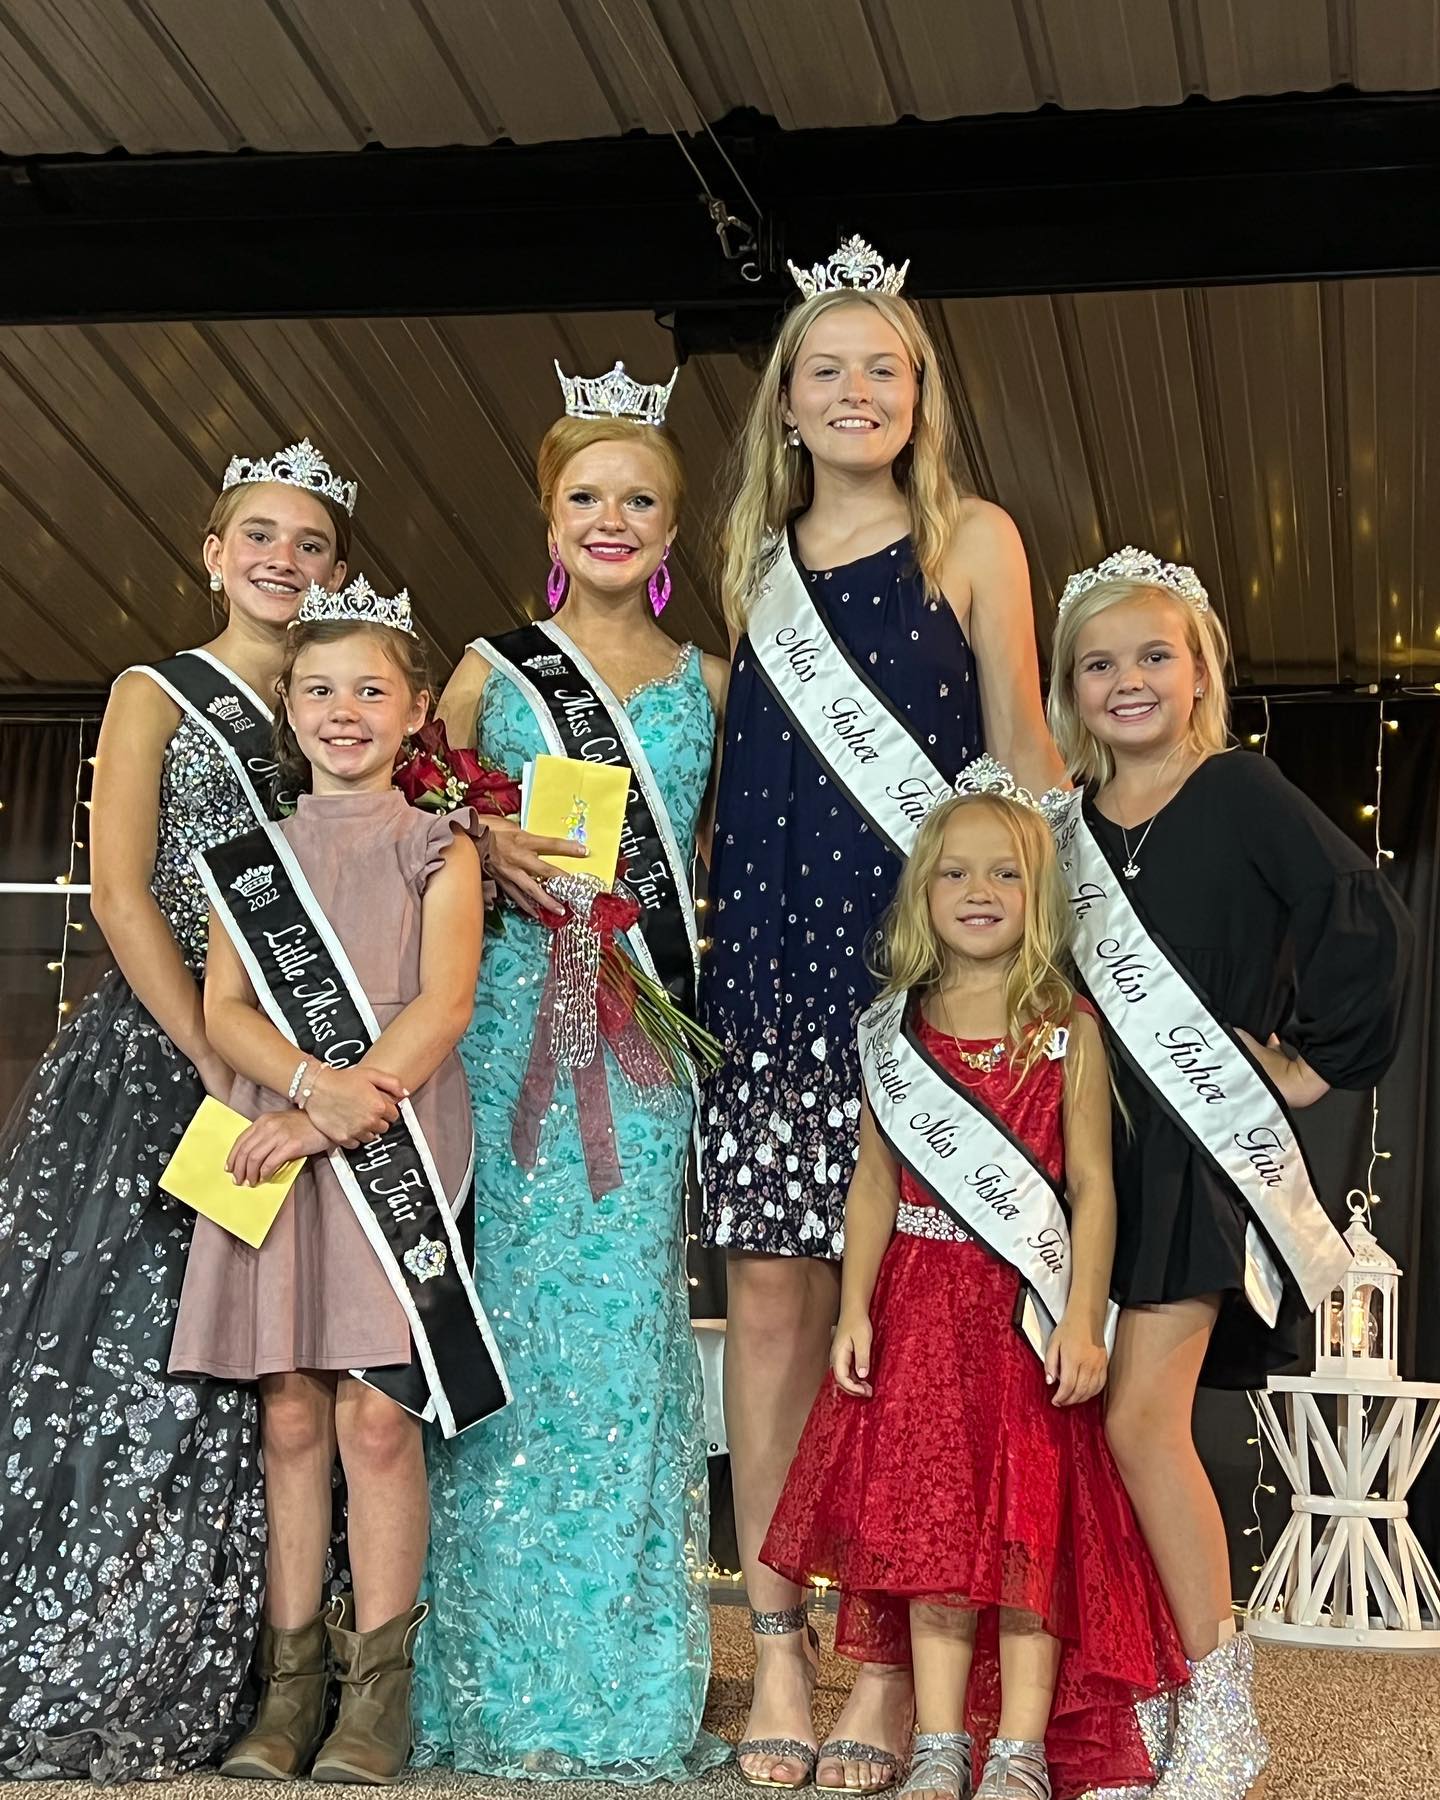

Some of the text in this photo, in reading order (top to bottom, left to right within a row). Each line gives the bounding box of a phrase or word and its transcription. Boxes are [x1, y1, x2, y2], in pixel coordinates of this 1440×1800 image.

[229, 717, 256, 734] 2022
[540, 666, 569, 678] 2022
[775, 627, 821, 683] Miss
[822, 697, 880, 764] Fisher
[554, 688, 602, 737] Miss
[624, 860, 670, 910] Fair
[247, 887, 281, 912] 2022
[262, 924, 306, 982] Little
[292, 978, 342, 1042] Miss
[369, 1168, 425, 1223] Fair
[1096, 938, 1148, 1004] Miss
[1155, 1025, 1226, 1105] Fisher
[1234, 1127, 1287, 1188] Fair
[875, 1050, 1064, 1274] Little Miss Fisher Fair
